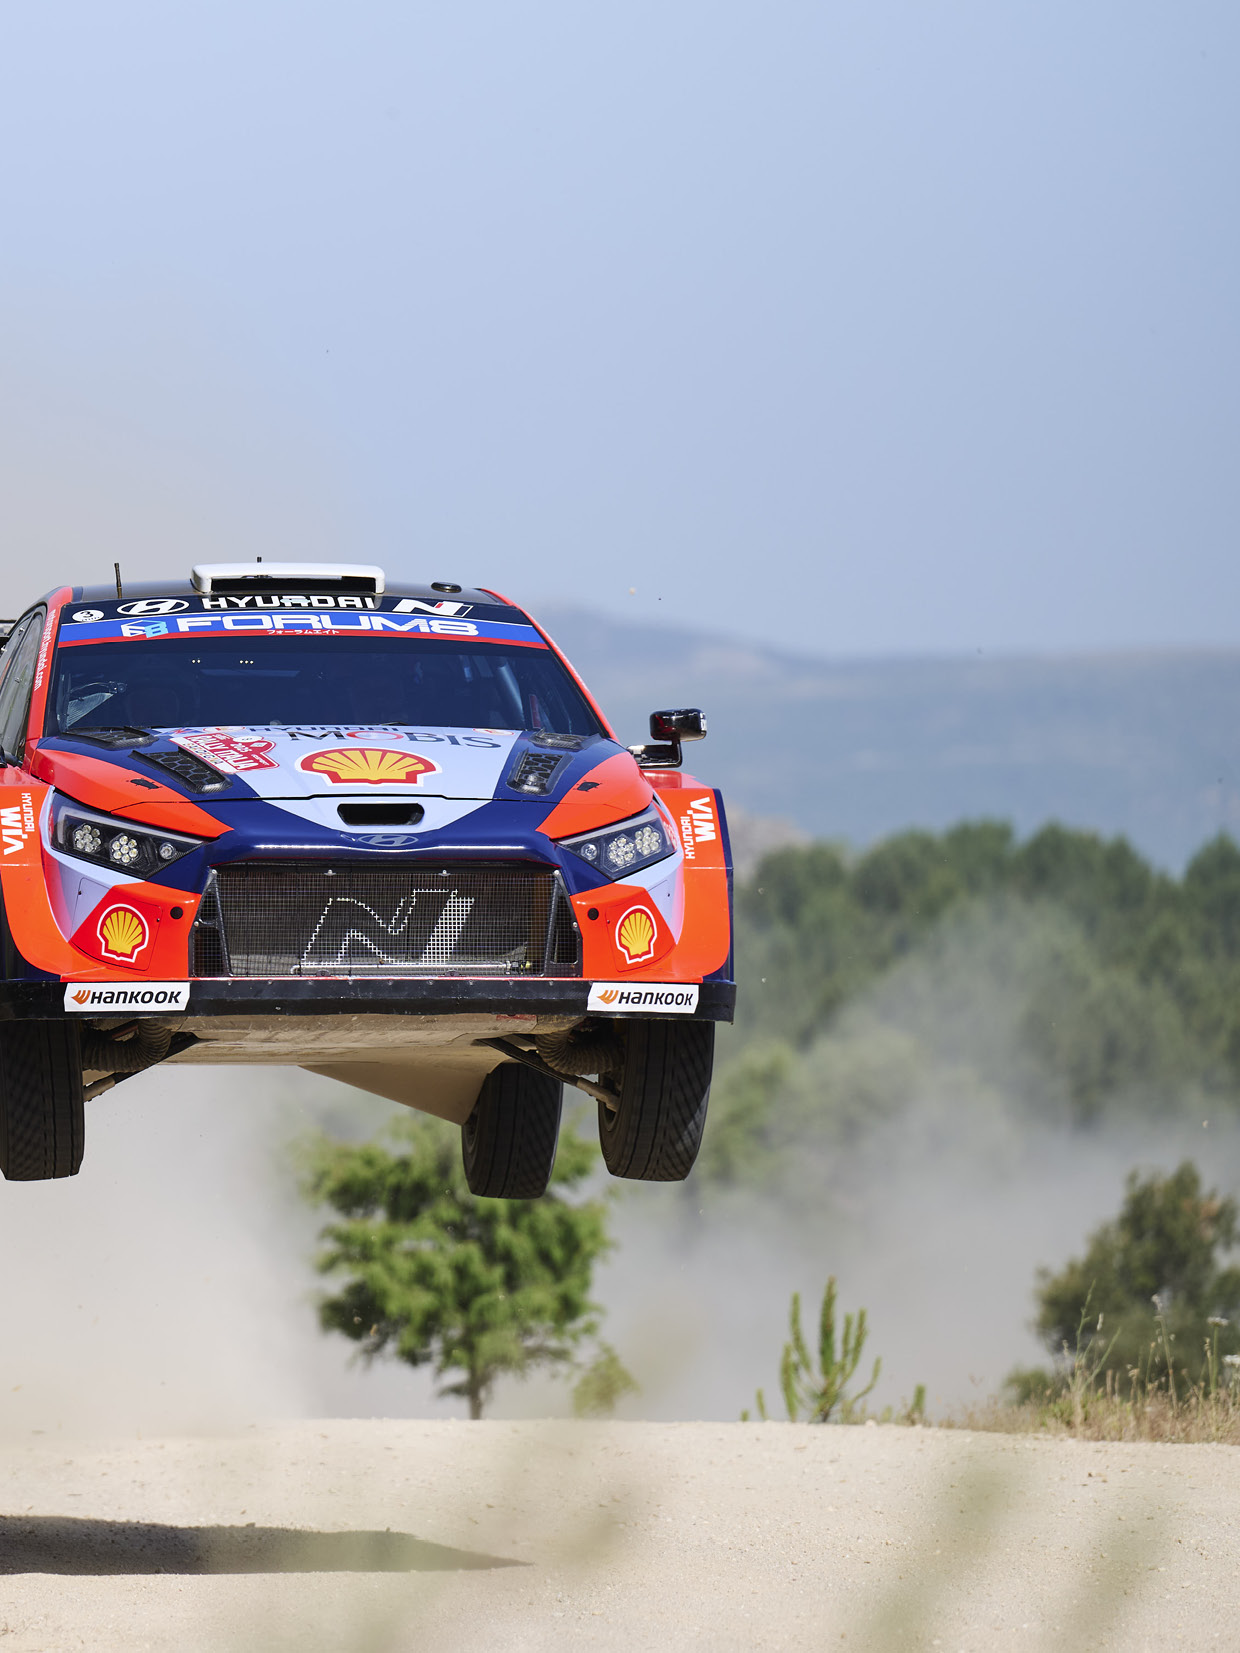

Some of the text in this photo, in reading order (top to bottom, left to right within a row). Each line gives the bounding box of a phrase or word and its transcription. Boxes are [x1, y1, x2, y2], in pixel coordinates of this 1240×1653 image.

[201, 595, 375, 609] HYUNDAI
[176, 614, 479, 636] FORUM8
[287, 730, 502, 749] MOBIS
[213, 749, 259, 770] ITALIA
[21, 793, 35, 832] HYUNDAI
[680, 816, 696, 859] HYUNDAI
